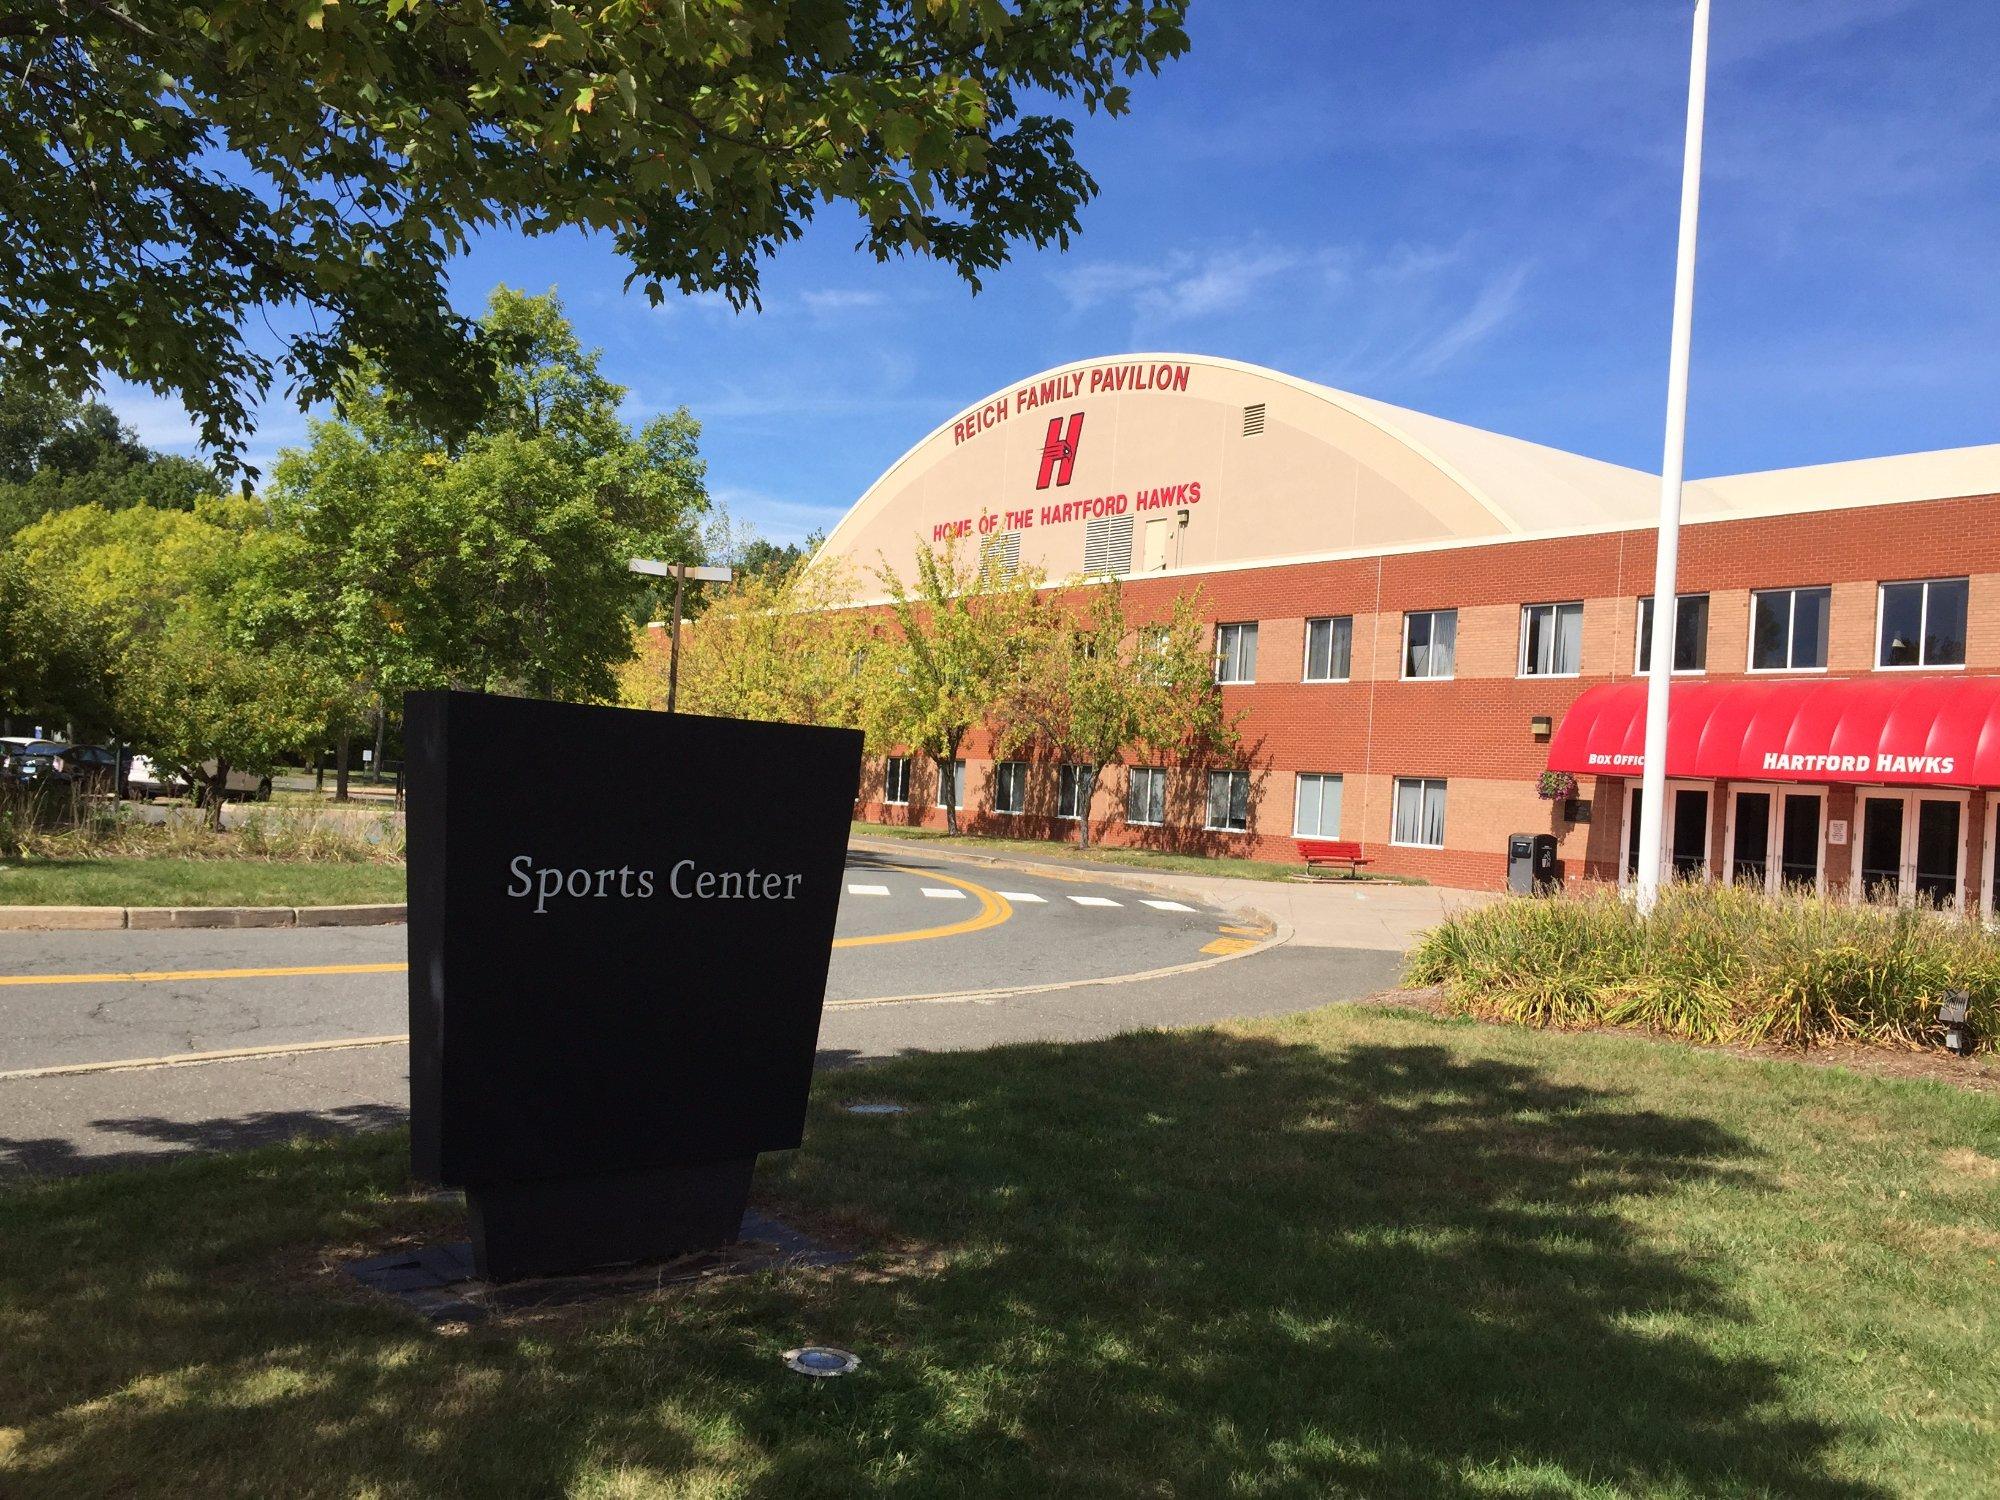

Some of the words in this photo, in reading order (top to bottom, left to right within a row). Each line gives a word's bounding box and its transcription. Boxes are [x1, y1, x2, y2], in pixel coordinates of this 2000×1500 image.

[954, 398, 1008, 446] REICH
[1016, 371, 1084, 414] FAMILY
[1090, 364, 1190, 393] PAVILION
[1036, 411, 1085, 490] H
[978, 514, 998, 535] OF
[1005, 508, 1033, 531] THE
[1041, 494, 1128, 526] HARTFORD
[1136, 481, 1201, 511] HAWKS
[1588, 753, 1612, 766] BOX
[1613, 753, 1645, 767] OFFIC
[1763, 752, 1870, 772] HARTFORD
[1876, 753, 1954, 774] HAWKS
[507, 855, 654, 914] Sports
[669, 859, 802, 900] Center
